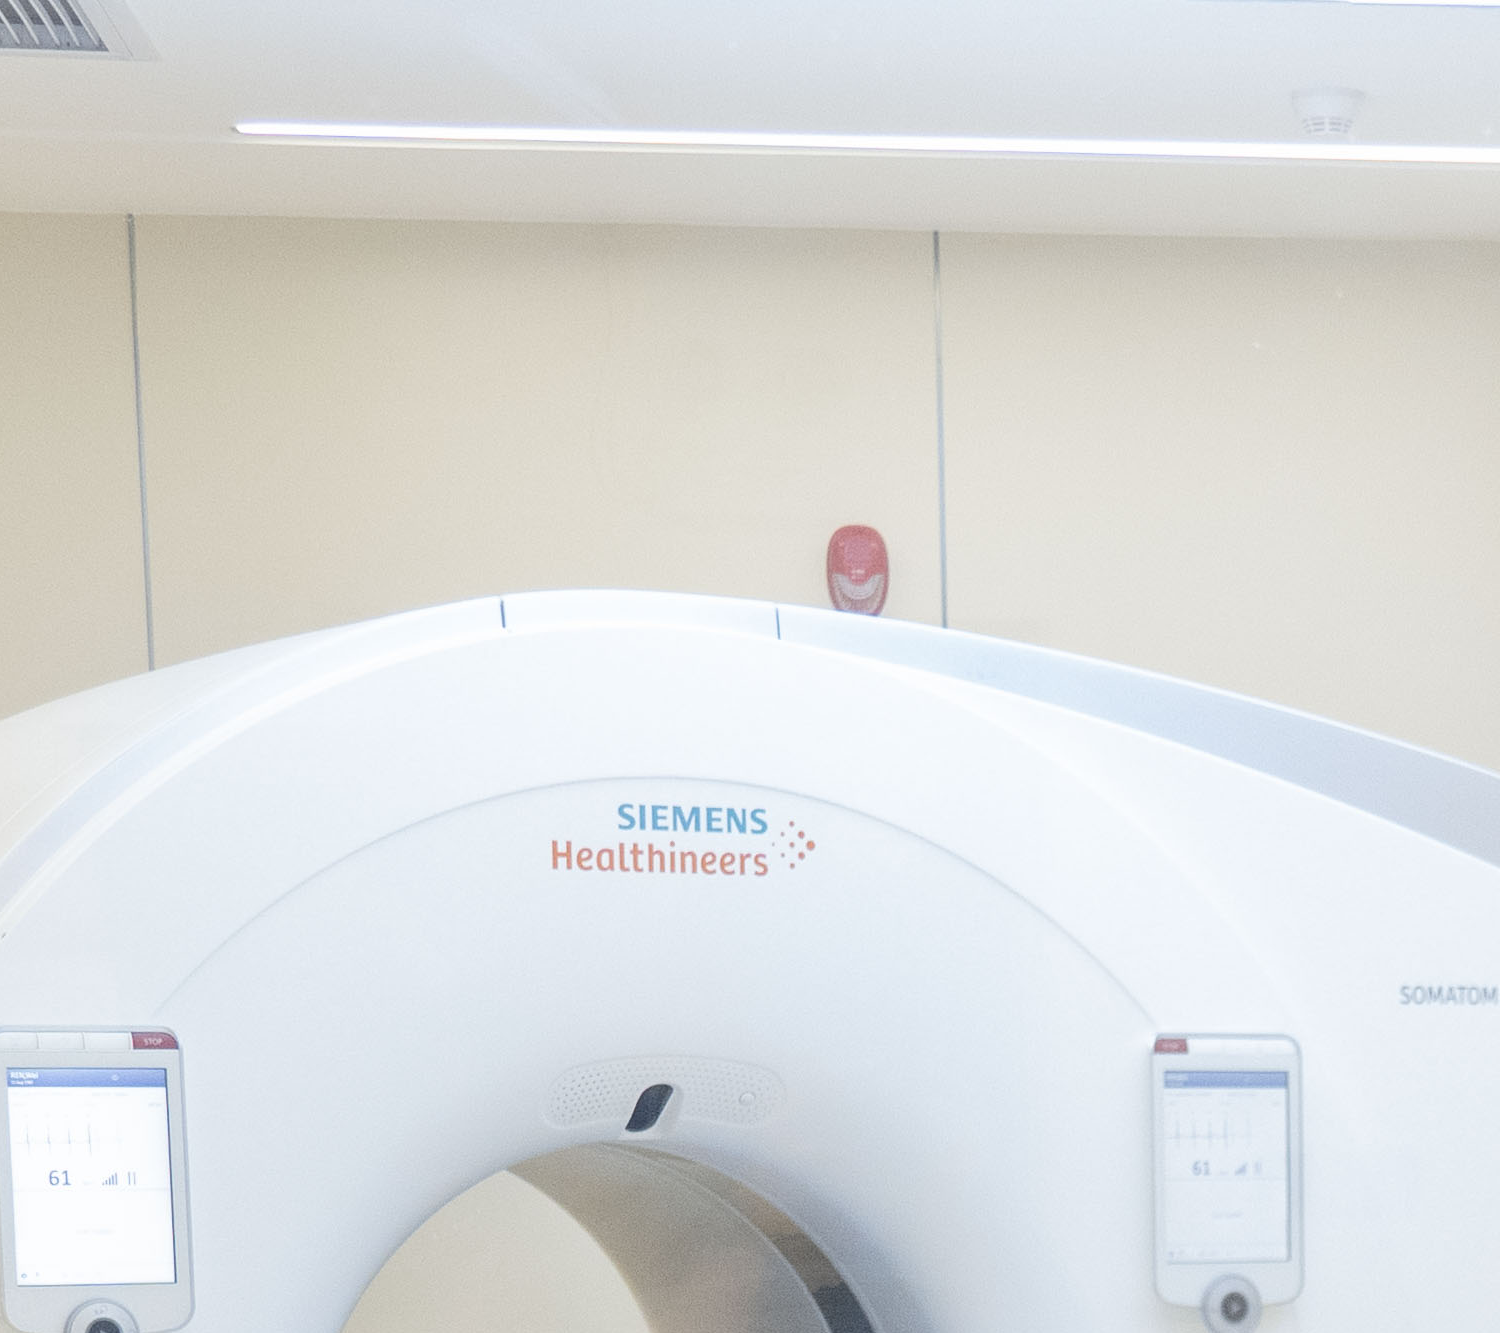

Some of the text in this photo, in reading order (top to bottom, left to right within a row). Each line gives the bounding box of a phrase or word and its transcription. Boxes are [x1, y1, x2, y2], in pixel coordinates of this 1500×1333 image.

[617, 803, 769, 835] SIEMENS
[551, 840, 769, 877] Healthineers
[1399, 985, 1499, 1006] SOMATOM
[143, 1036, 164, 1047] STOP
[48, 1170, 73, 1187] 61
